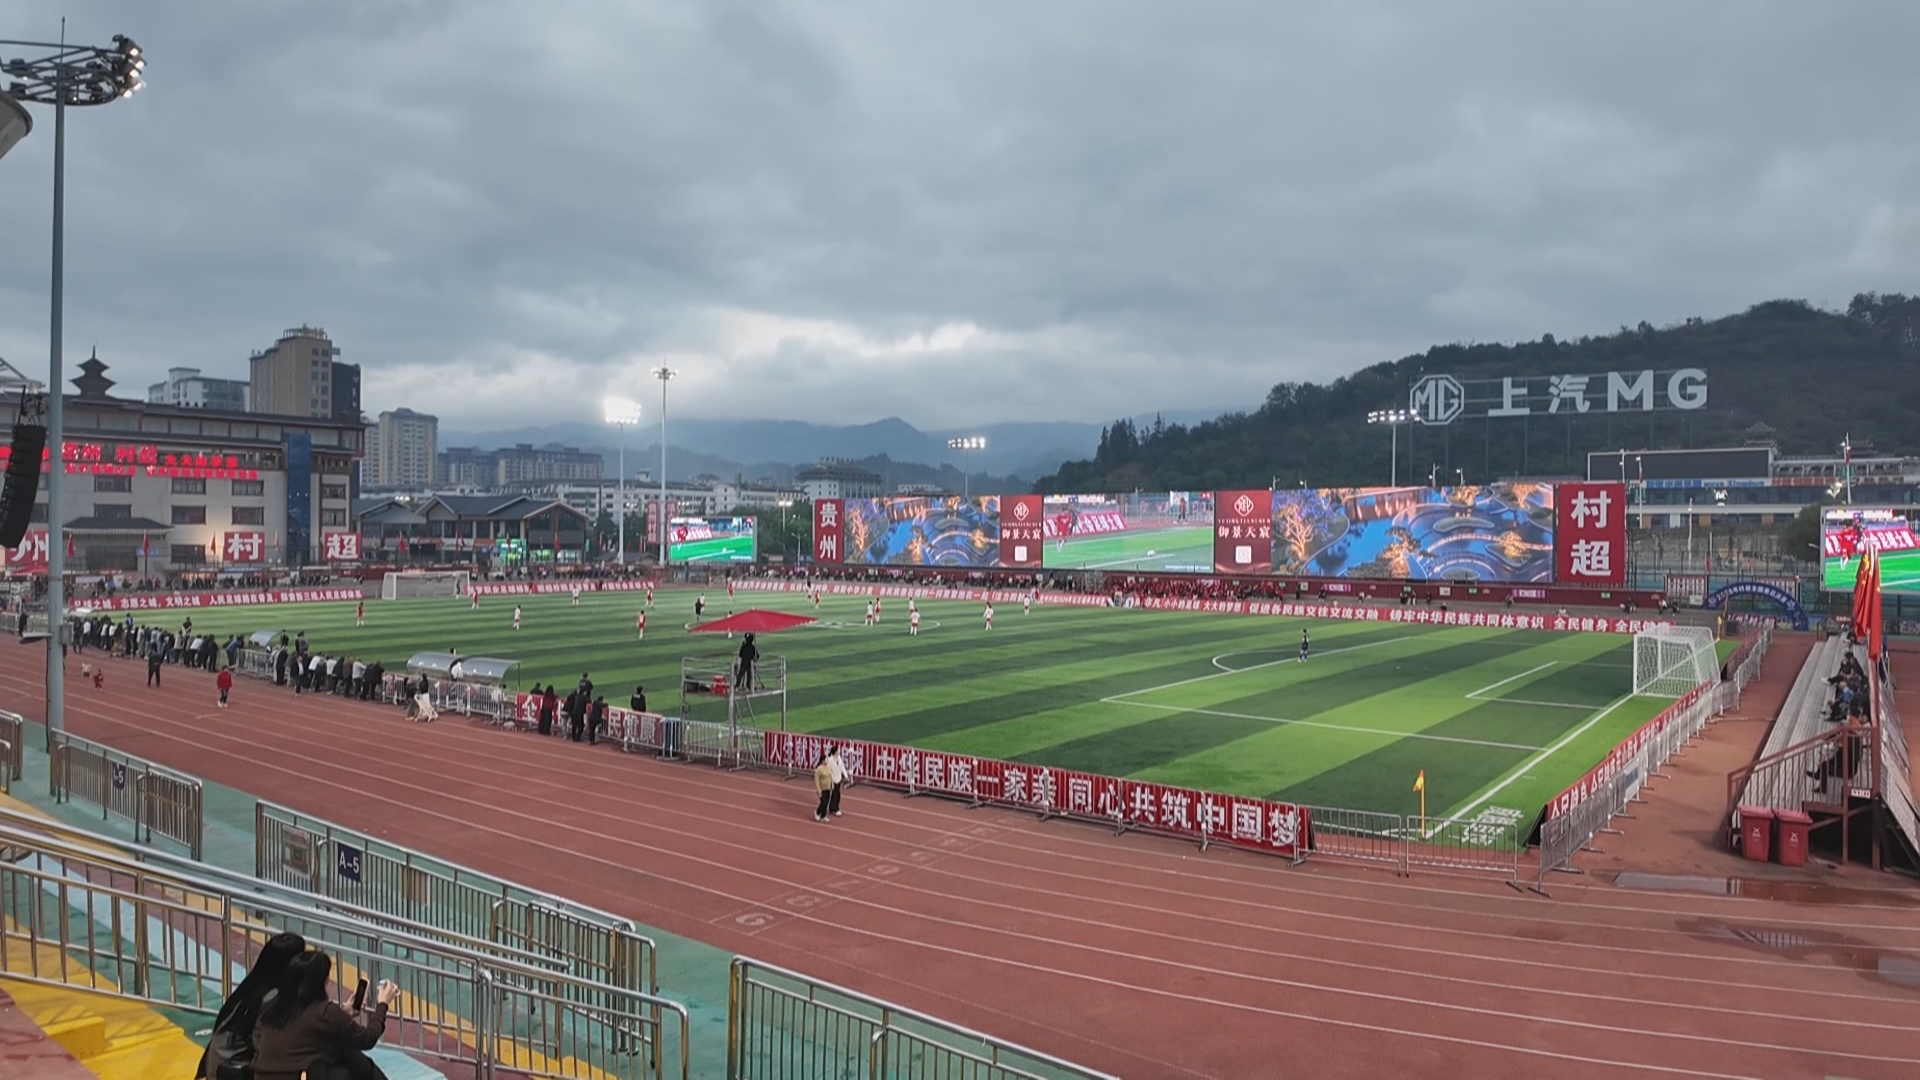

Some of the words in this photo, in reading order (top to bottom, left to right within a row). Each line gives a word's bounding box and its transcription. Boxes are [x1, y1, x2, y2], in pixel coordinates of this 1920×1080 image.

[1413, 377, 1461, 422] MG
[227, 533, 262, 560] 村
[327, 533, 358, 559] 超
[820, 501, 838, 560] 贵州
[1570, 490, 1612, 576] 村超
[1249, 602, 1379, 620] 促进各民族交往交流交融
[1390, 608, 1544, 629] 铸牢中华民族共同体意识
[1554, 617, 1608, 632] 全民健身
[602, 707, 656, 744] 民健康
[338, 851, 361, 874] A-5
